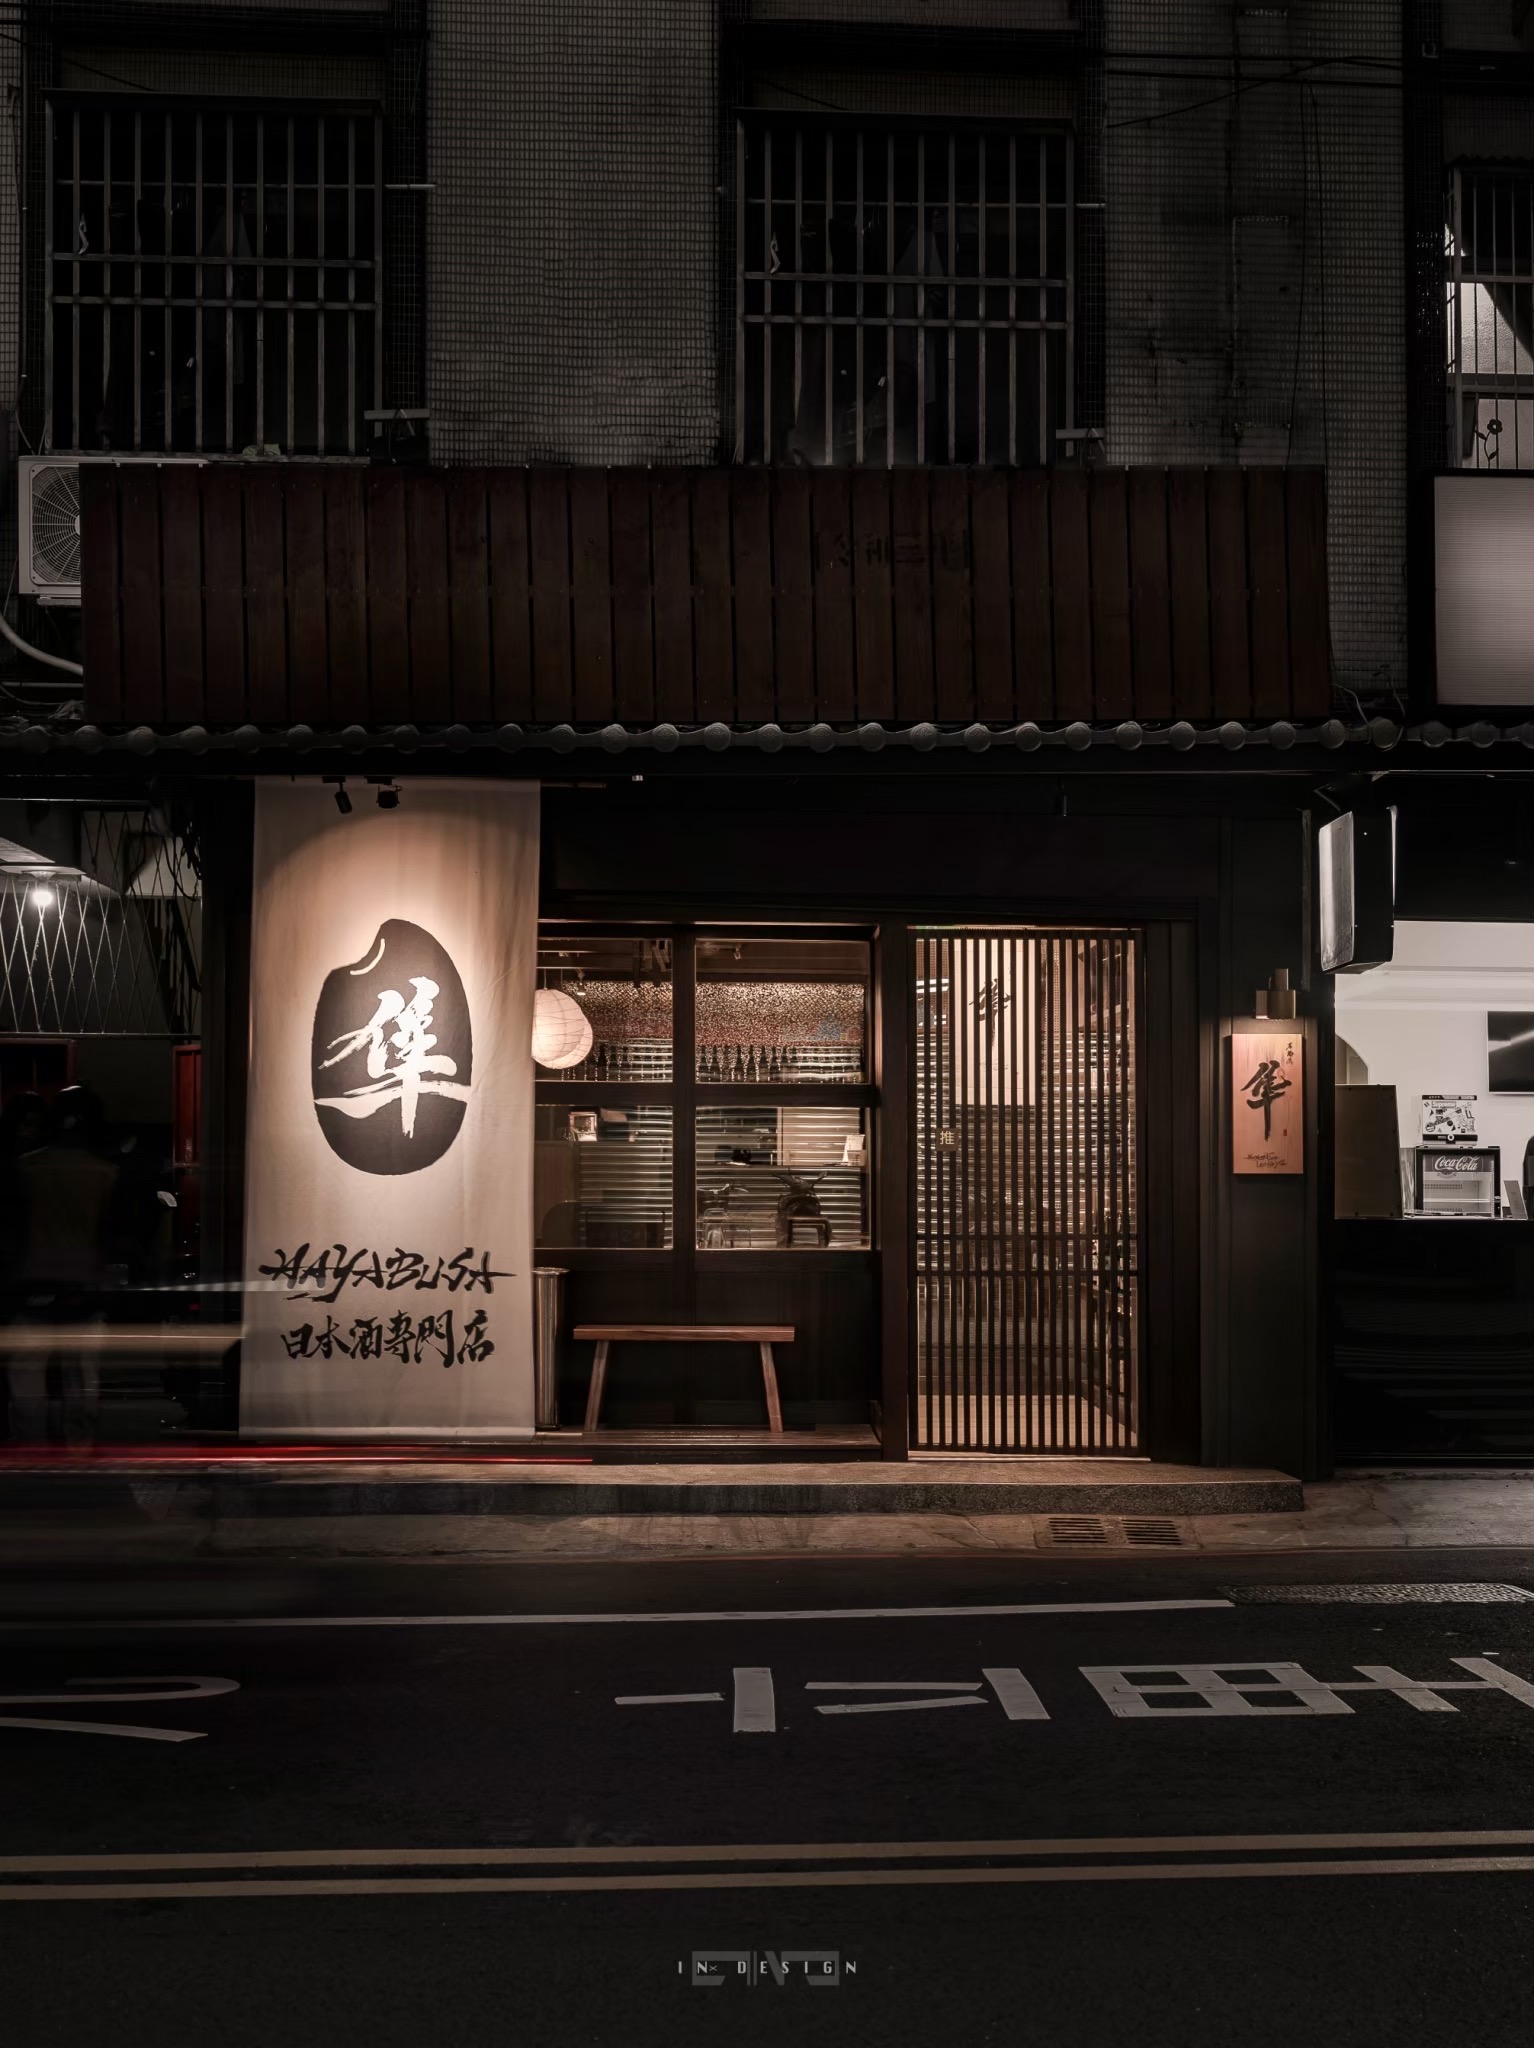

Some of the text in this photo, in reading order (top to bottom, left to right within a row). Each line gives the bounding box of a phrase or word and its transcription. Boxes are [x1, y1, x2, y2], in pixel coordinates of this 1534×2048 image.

[1240, 1060, 1292, 1142] 隼
[939, 1130, 955, 1145] 推
[1434, 1156, 1480, 1170] Coca-Cola
[258, 1243, 517, 1303] HAYABUSA
